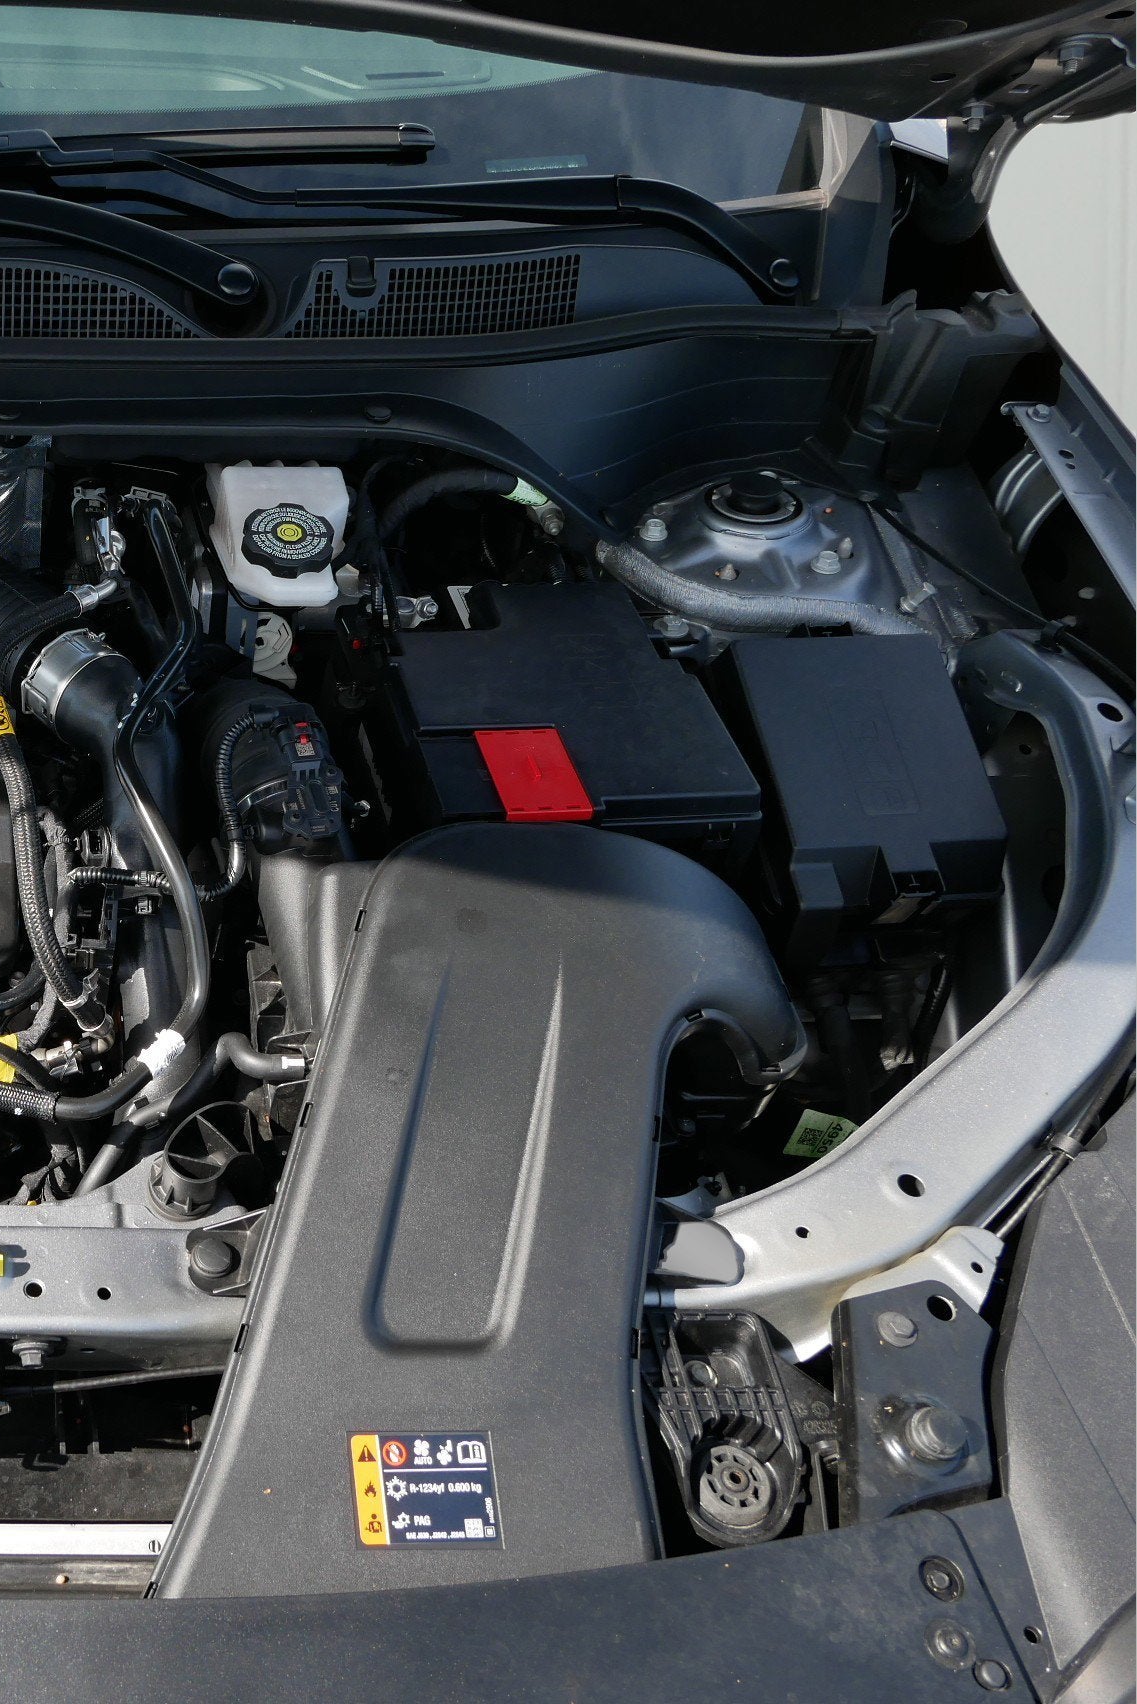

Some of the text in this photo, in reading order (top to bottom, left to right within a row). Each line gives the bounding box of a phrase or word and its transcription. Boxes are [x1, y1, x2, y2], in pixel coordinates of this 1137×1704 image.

[413, 1456, 433, 1465] AUTO
[471, 1482, 482, 1494] kg
[413, 1515, 431, 1526] PAG
